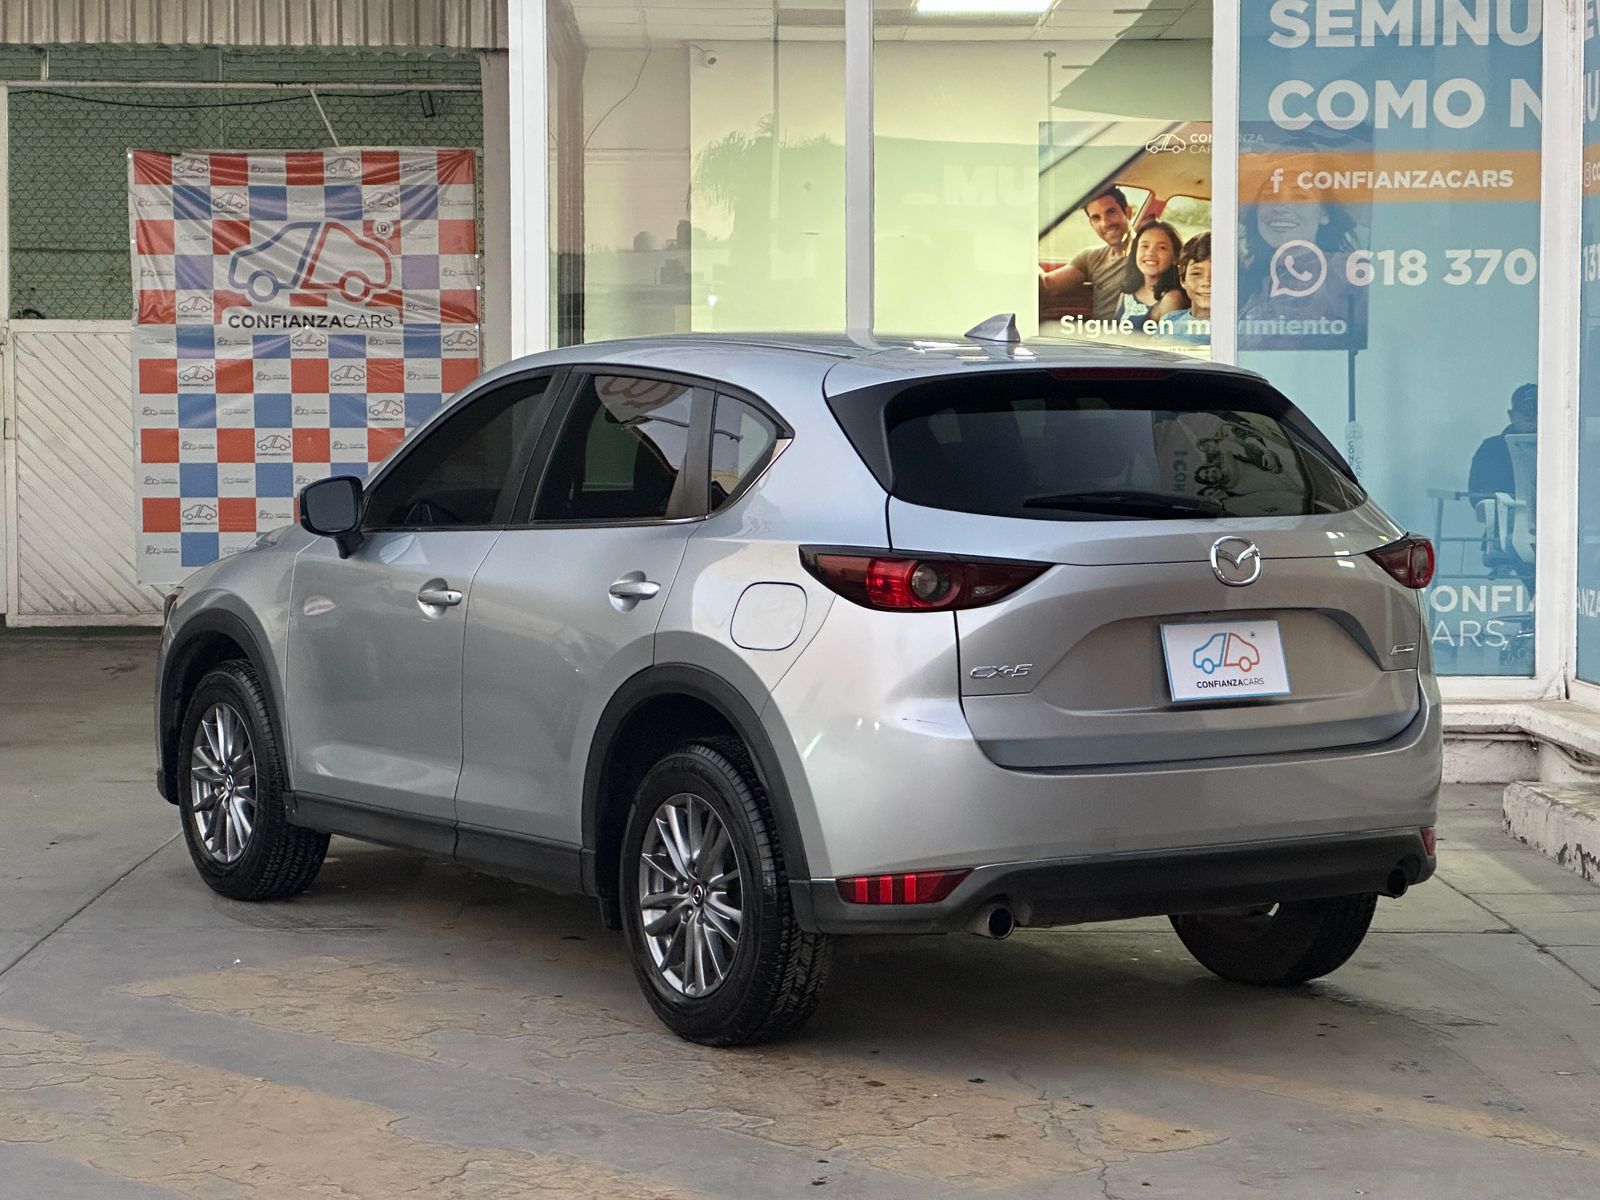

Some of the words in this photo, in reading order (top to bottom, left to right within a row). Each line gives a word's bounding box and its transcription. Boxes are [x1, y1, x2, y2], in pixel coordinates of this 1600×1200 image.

[1268, 0, 1541, 48] SEMINU
[1268, 78, 1486, 130] COMO
[1296, 169, 1514, 190] CONFIANZACARS
[1345, 249, 1428, 287] 618
[1442, 248, 1538, 286] 370
[228, 314, 394, 329] CONFIANZACARS
[1059, 314, 1134, 338] Sigue
[1142, 318, 1174, 335] en
[1431, 620, 1505, 648] ARS
[969, 663, 1033, 679] CX-5
[1196, 677, 1265, 689] CONFIANZACARS
